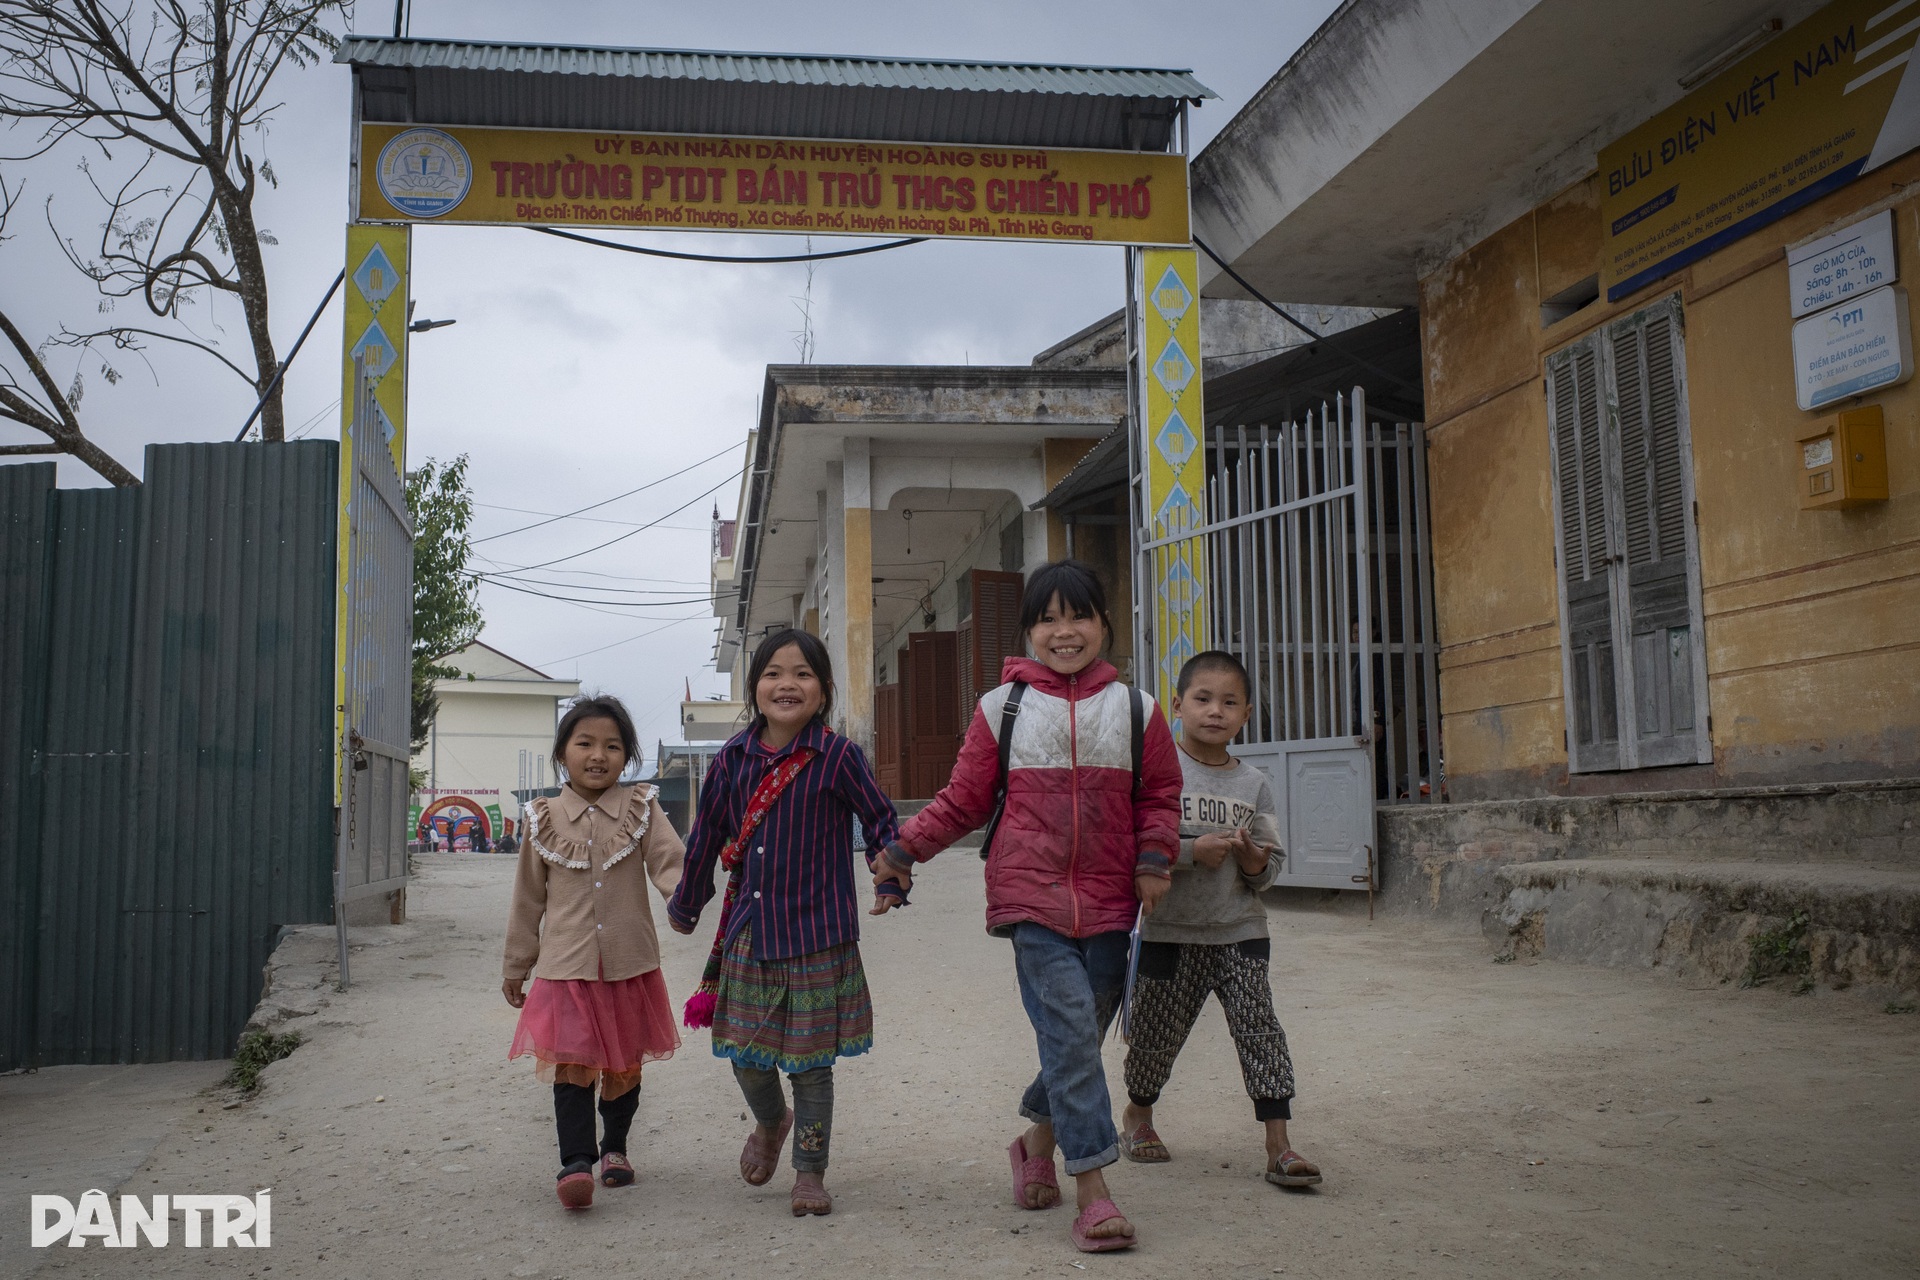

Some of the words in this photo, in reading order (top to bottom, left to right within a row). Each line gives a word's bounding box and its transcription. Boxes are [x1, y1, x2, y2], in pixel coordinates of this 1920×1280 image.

[1660, 111, 1716, 165] ĐIỆN
[1725, 70, 1779, 123] VIỆT
[1793, 25, 1856, 86] NAM
[594, 134, 625, 154] UỶ
[630, 140, 680, 156] BAN
[685, 139, 750, 159] NHÂN
[756, 141, 805, 160] DÂN
[810, 144, 882, 166] HUYỆN
[887, 145, 975, 167] HOÀNG
[980, 153, 1007, 167] SU
[1012, 150, 1047, 169] PHÌ
[1833, 128, 1856, 146] GIANG
[490, 153, 633, 200] TRƯỜNG
[642, 165, 727, 203] PTDT
[737, 163, 807, 206] BÁN
[818, 167, 882, 208] TRÚ
[892, 175, 977, 212] THCS
[986, 170, 1079, 217] CHIẾN
[1088, 174, 1152, 220] PHỐ
[516, 203, 541, 220] Địa
[544, 203, 570, 218] chỉ:
[572, 204, 607, 220] Thôn
[610, 203, 651, 221] Chiến
[655, 205, 683, 222] Phố
[748, 209, 768, 225] Xã
[772, 209, 813, 226] Chiến
[851, 213, 895, 232] Huyện
[899, 214, 945, 234] Hoàng
[948, 216, 965, 232] Su
[998, 216, 1025, 234] Tỉnh
[1028, 219, 1048, 234] Hà
[1052, 220, 1093, 240] Giang
[1714, 212, 1732, 225] Giang
[1806, 274, 1833, 291] Sáng:
[1835, 267, 1848, 279] 8h
[1859, 256, 1876, 270] 10h
[1813, 258, 1829, 274] GIỜ
[1831, 251, 1845, 267] MỞ
[1847, 245, 1866, 260] CỬA
[1803, 290, 1833, 307] Chiều:
[1837, 282, 1854, 295] 14h
[1865, 271, 1882, 284] 16h
[1842, 308, 1864, 328] PTI
[1809, 356, 1831, 371] ĐIỂM
[1830, 350, 1847, 363] BÁN
[1847, 343, 1864, 357] BẢO
[1865, 334, 1886, 350] HIỂM
[1814, 372, 1822, 382] TÔ
[1826, 368, 1834, 378] XE
[1835, 363, 1849, 375] MÁY
[1853, 358, 1867, 368] CON
[1867, 349, 1890, 362] NGƯỜI
[1181, 797, 1192, 821] E
[1199, 797, 1226, 824] GOD
